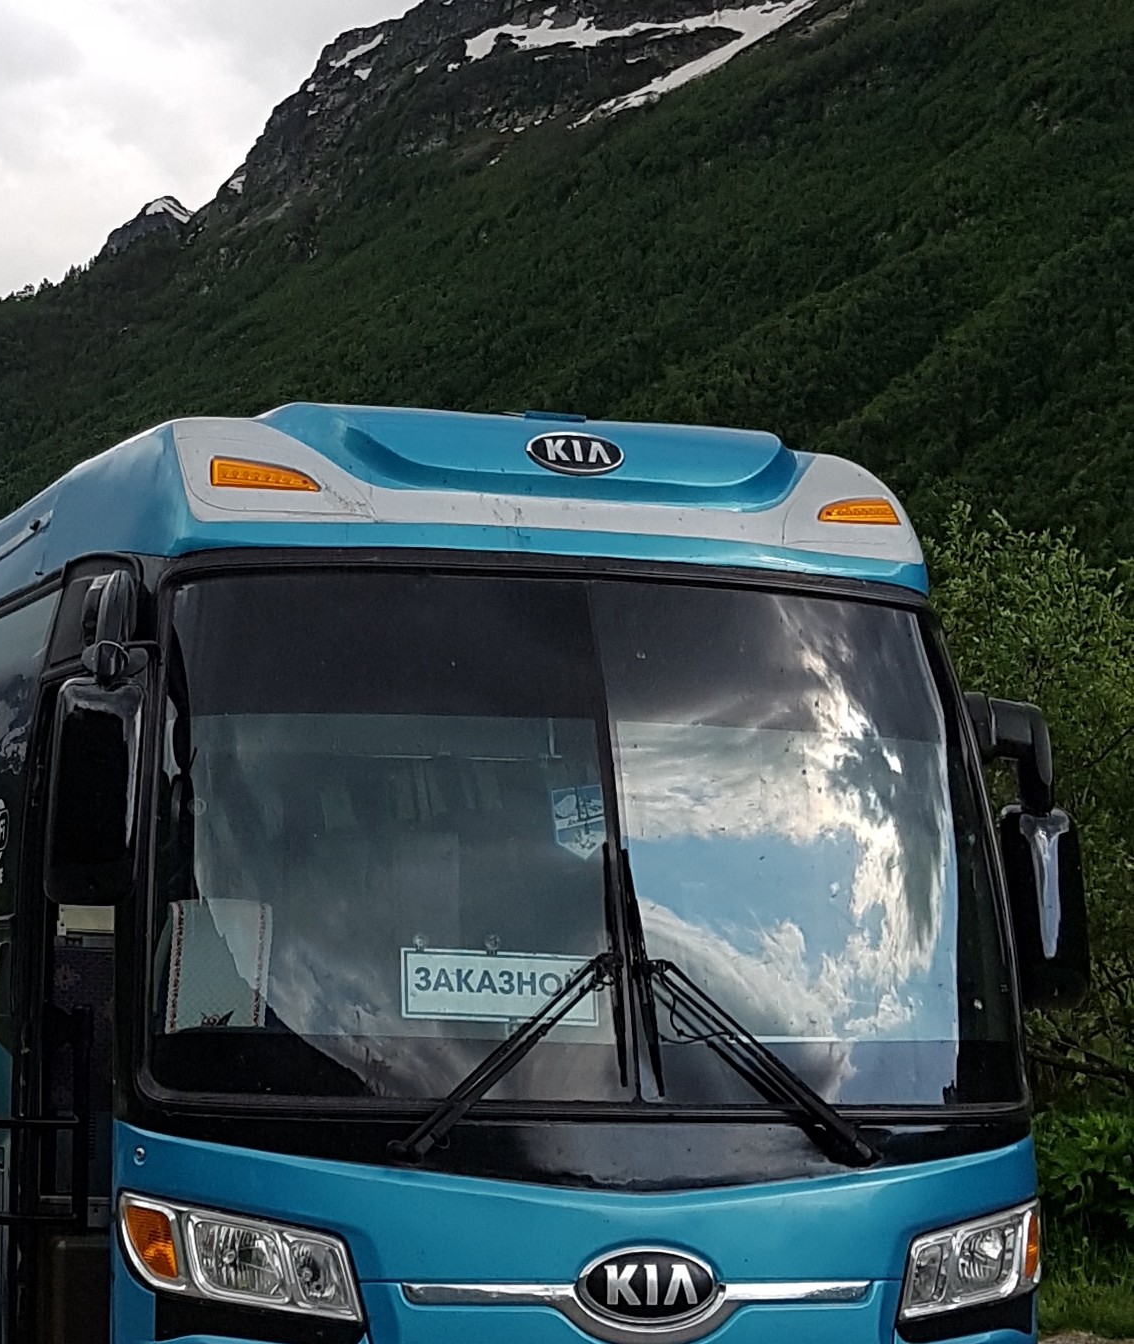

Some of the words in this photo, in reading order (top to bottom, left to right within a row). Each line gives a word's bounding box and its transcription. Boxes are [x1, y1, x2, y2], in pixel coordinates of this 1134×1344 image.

[543, 438, 612, 465] KIA
[414, 967, 579, 997] ЗАКАЗНО
[604, 1264, 698, 1306] KIA
